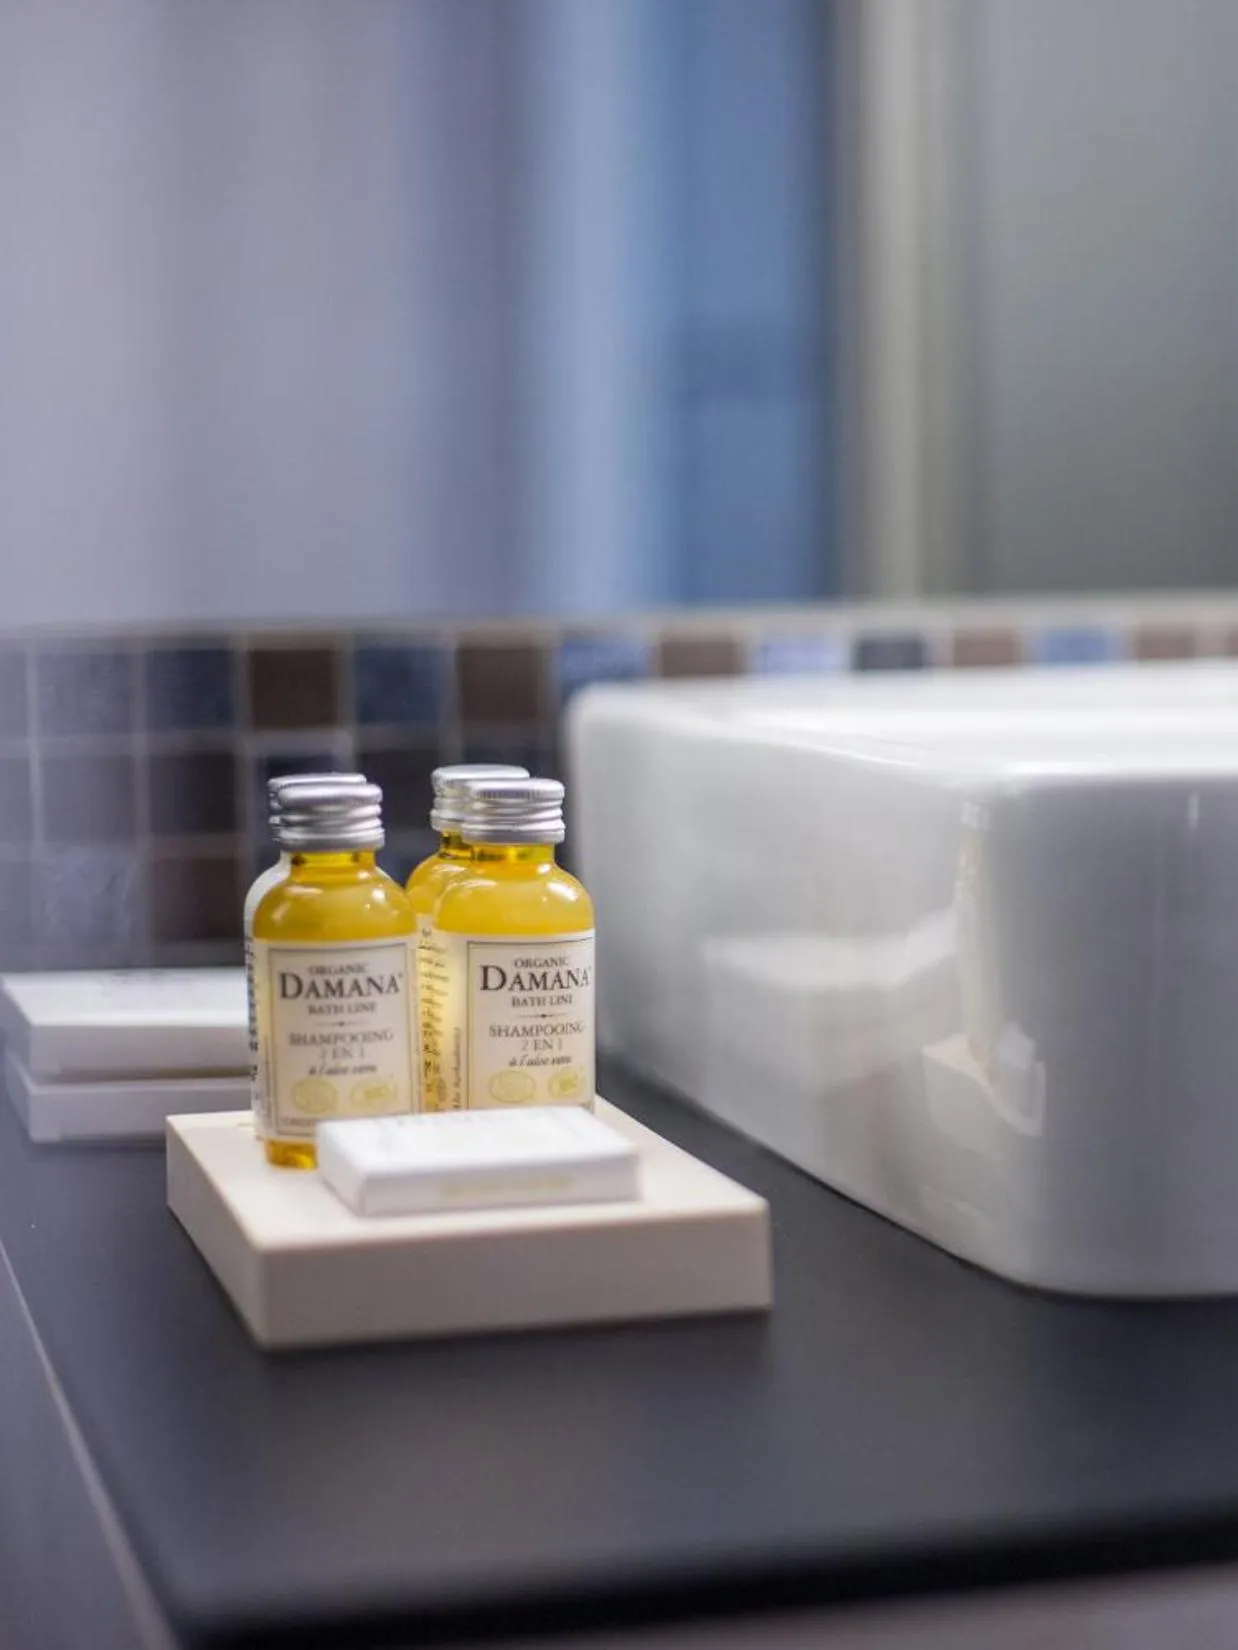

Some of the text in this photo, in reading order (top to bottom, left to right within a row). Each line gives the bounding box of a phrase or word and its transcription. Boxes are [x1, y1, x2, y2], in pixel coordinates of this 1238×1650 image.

[513, 956, 570, 969] ORGANIC
[279, 972, 400, 999] DAMANA
[478, 964, 590, 992] DAMANA
[511, 995, 547, 1008] BATH
[489, 1021, 587, 1038] SHAMPOOING
[521, 1040, 529, 1051] 2
[533, 1039, 554, 1052] EN
